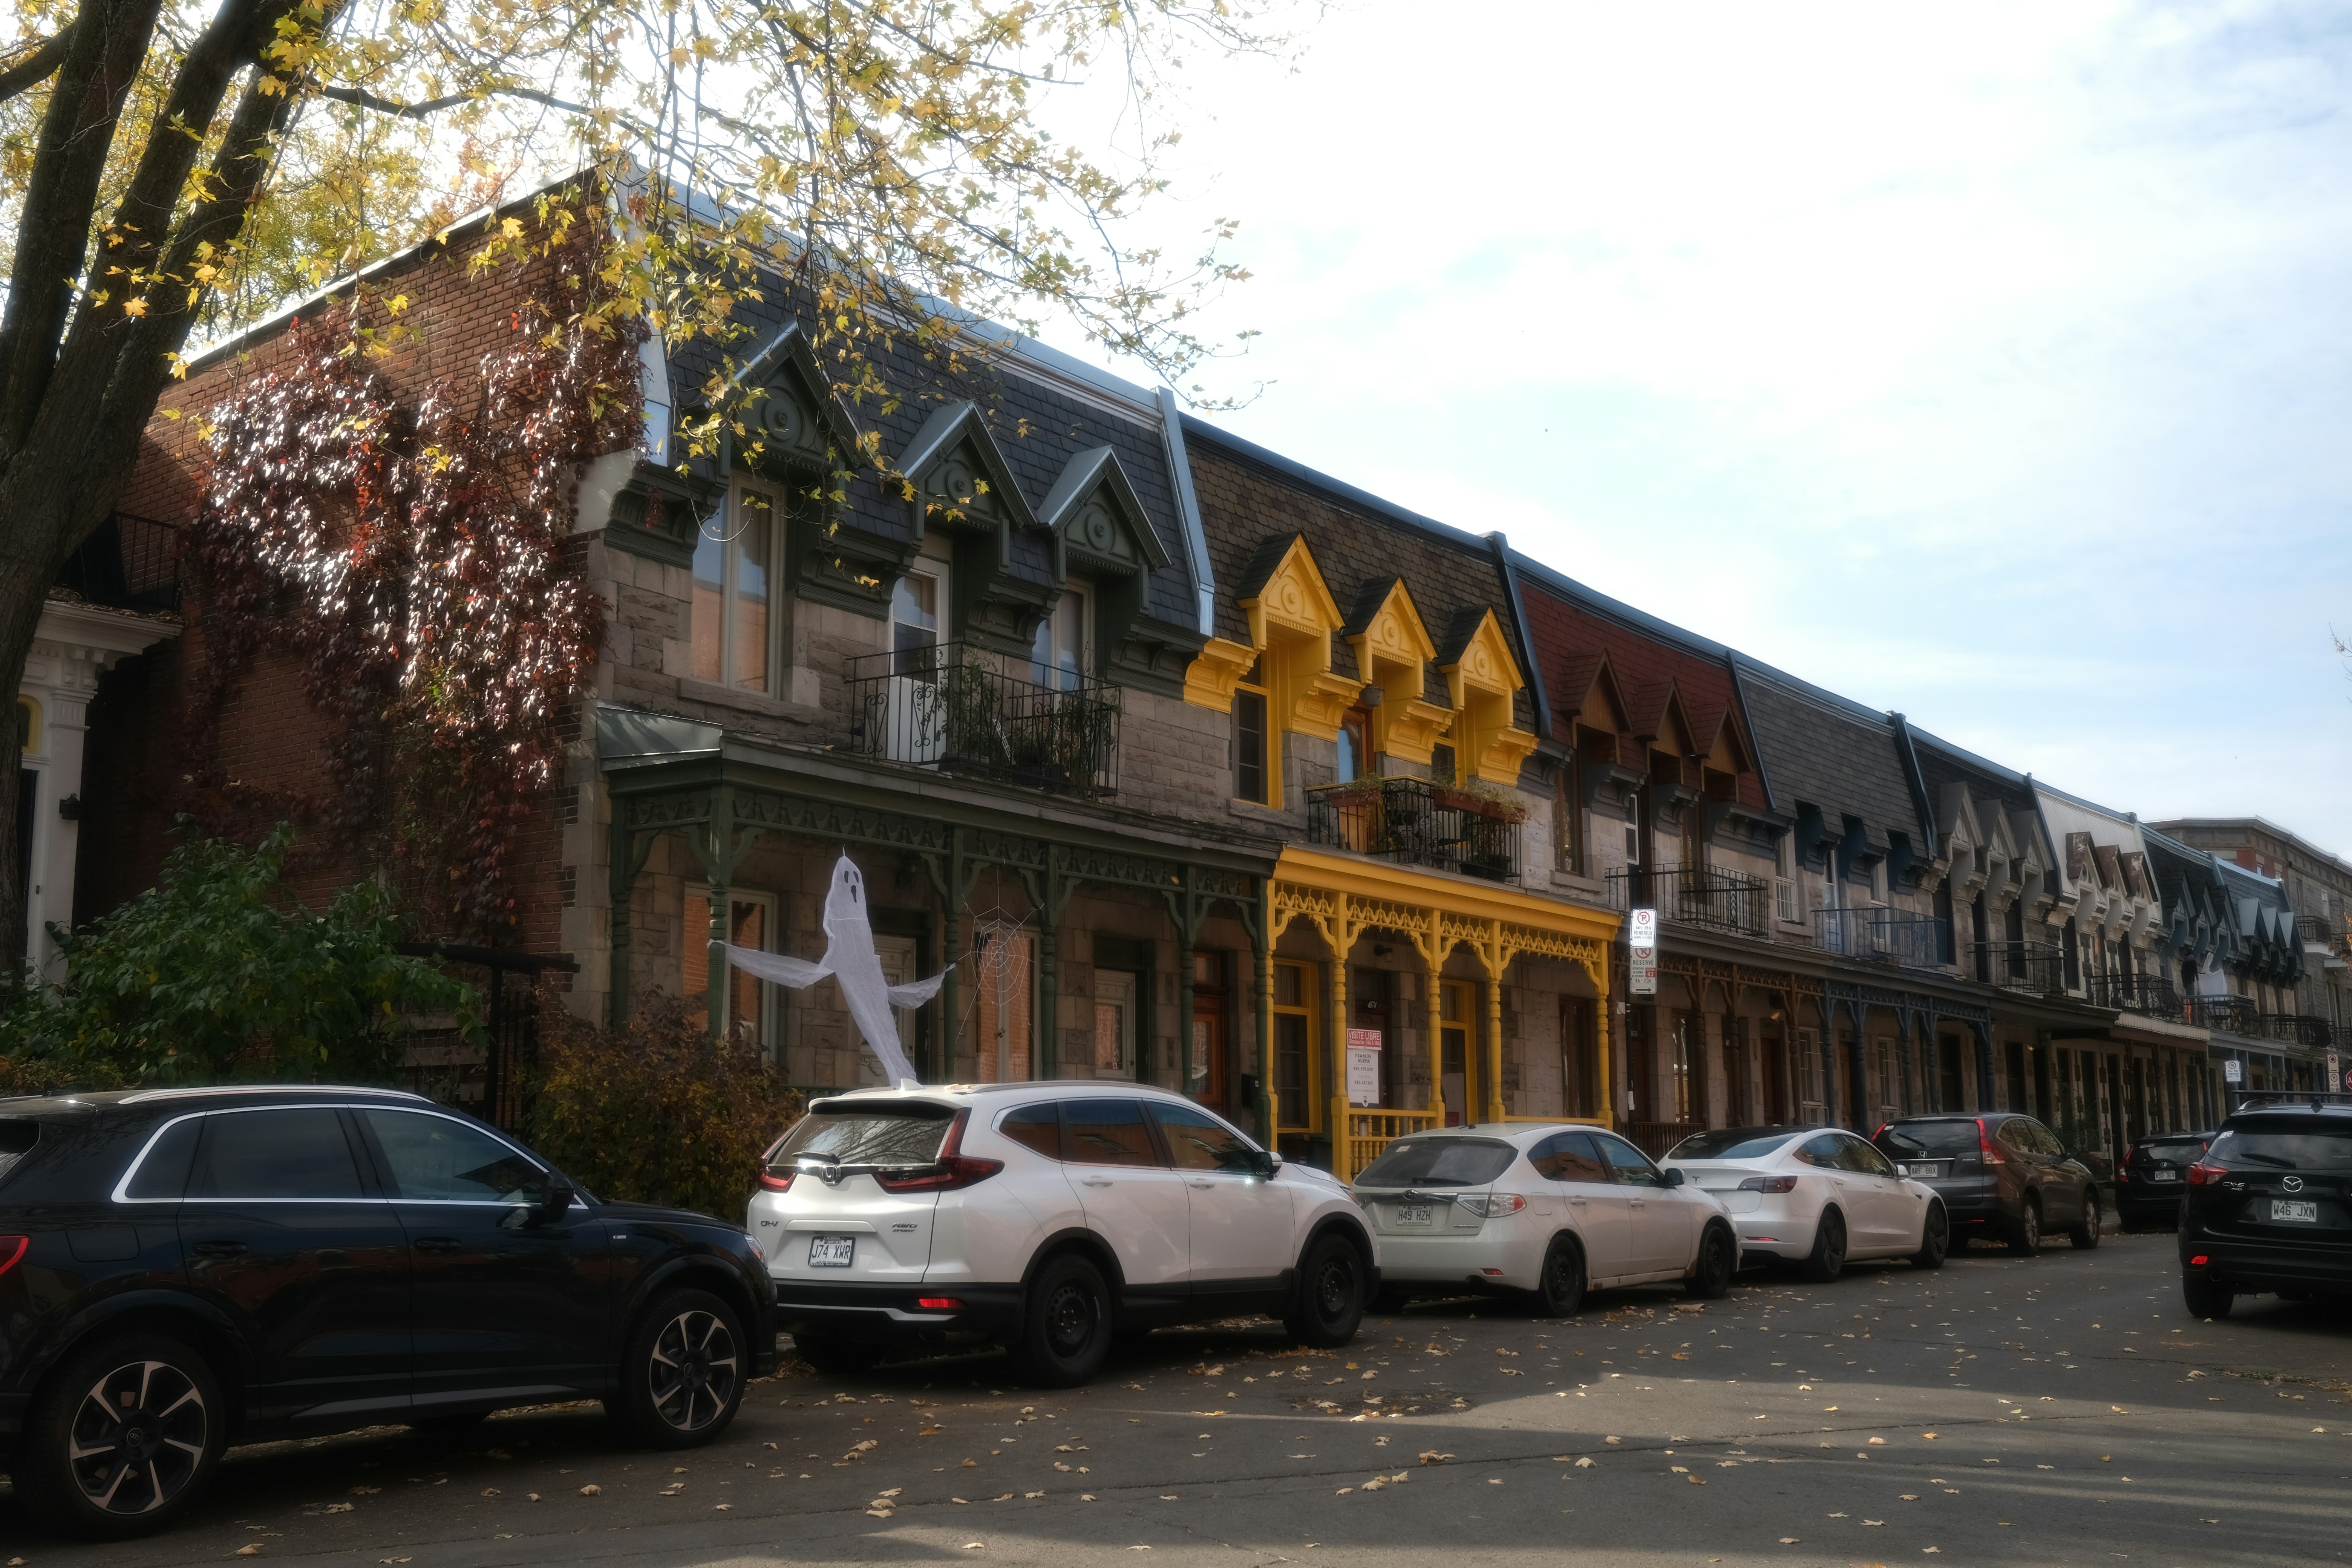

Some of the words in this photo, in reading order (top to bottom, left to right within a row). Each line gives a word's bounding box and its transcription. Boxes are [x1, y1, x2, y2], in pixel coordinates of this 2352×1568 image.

[1348, 1031, 1364, 1040] VISITE
[1365, 1032, 1380, 1041] LIBRE
[1398, 1210, 1412, 1220] H49
[1416, 1210, 1430, 1220] HZH
[2274, 1205, 2291, 1216] W46
[2297, 1206, 2315, 1217] JXN
[812, 1244, 829, 1258] J74
[833, 1245, 850, 1259] XWR
